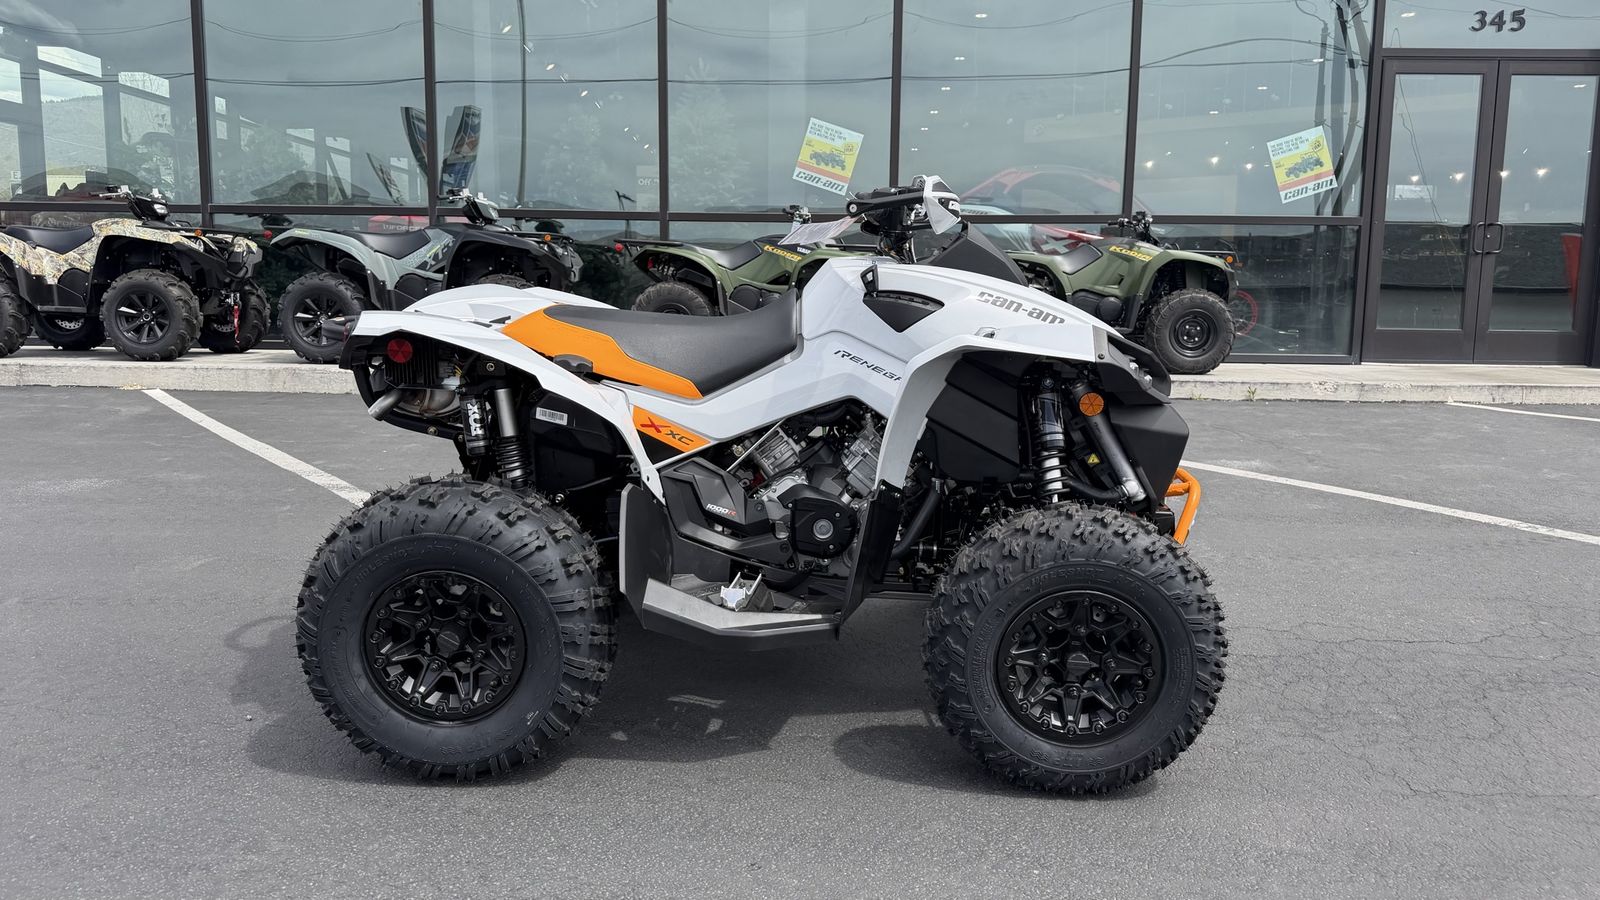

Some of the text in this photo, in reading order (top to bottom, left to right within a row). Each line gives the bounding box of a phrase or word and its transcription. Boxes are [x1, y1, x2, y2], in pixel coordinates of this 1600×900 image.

[1470, 8, 1526, 32] 345
[796, 171, 845, 191] can-am
[1284, 178, 1334, 200] can-am
[976, 291, 1065, 324] can-am
